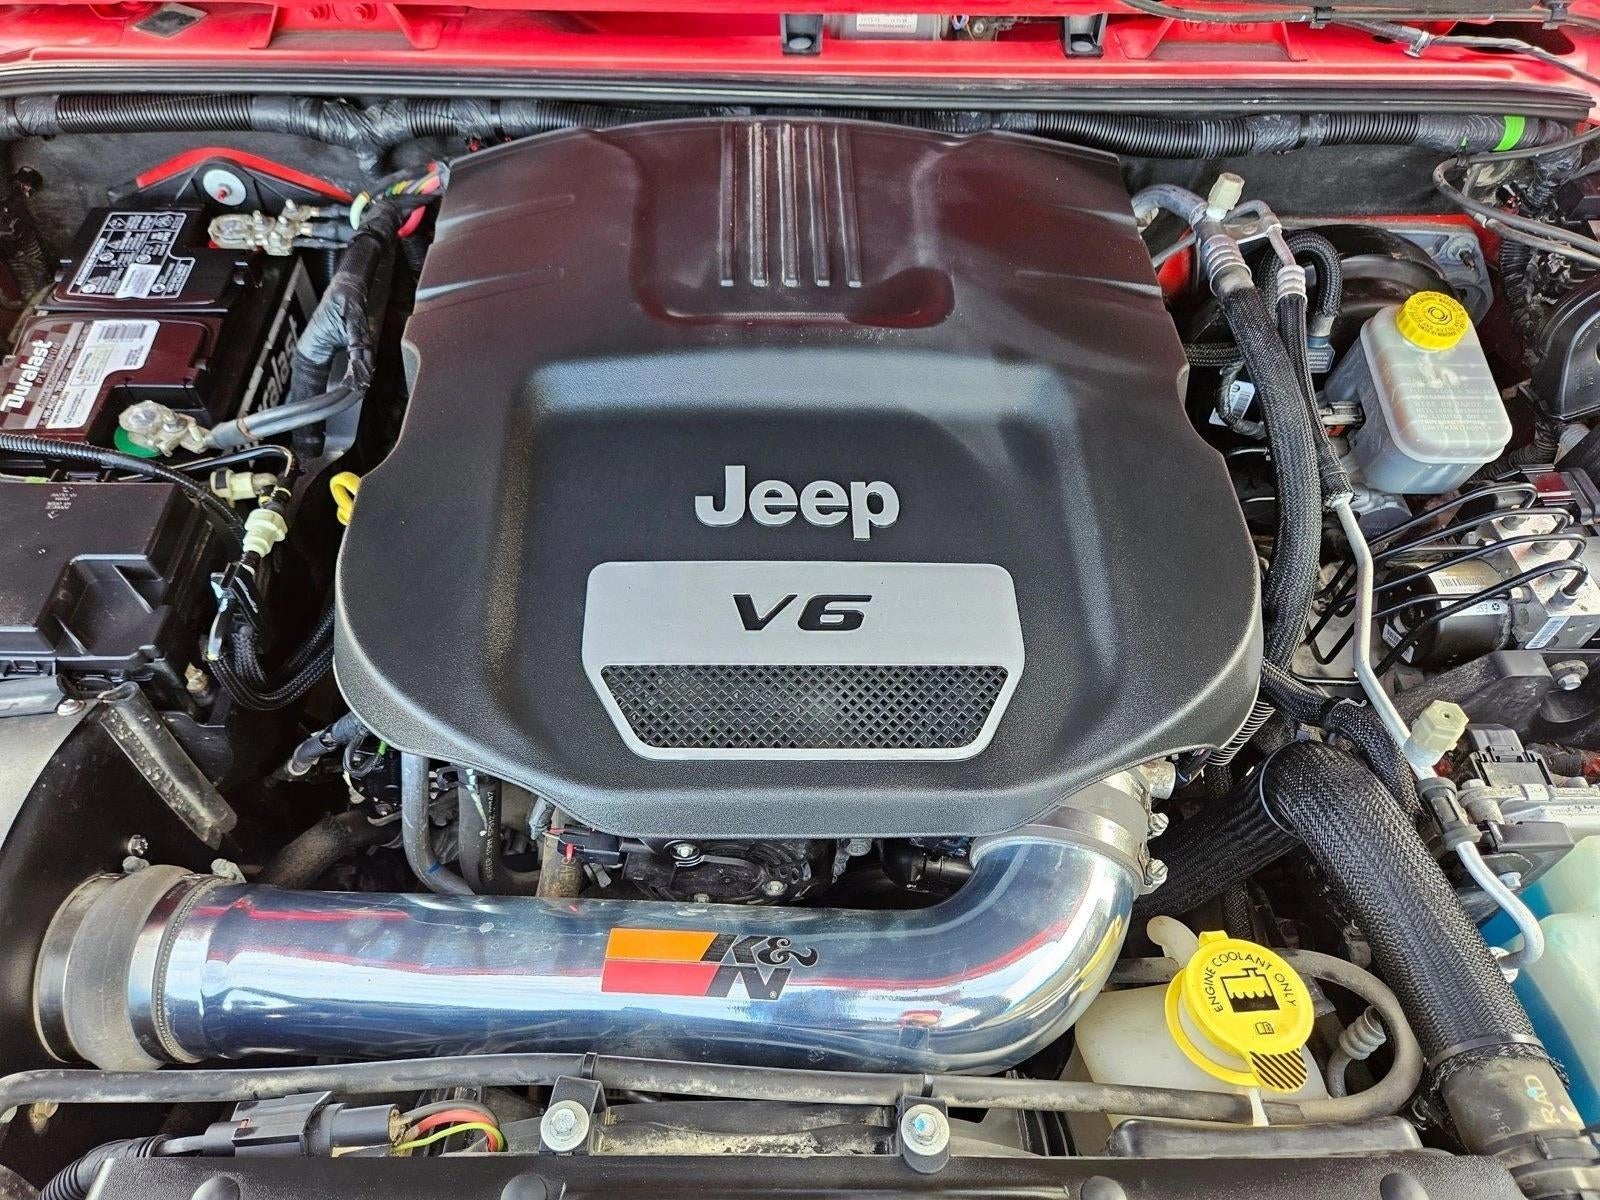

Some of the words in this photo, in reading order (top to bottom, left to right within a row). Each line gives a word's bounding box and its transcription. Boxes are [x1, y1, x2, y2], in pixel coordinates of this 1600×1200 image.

[0, 339, 53, 412] Duralast
[35, 341, 60, 385] PLATINUM
[695, 465, 900, 541] Jeep
[732, 594, 873, 632] V6
[1212, 951, 1273, 970] COOLANT
[1203, 966, 1224, 1013] ENGINE
[1274, 973, 1297, 1007] ONLY
